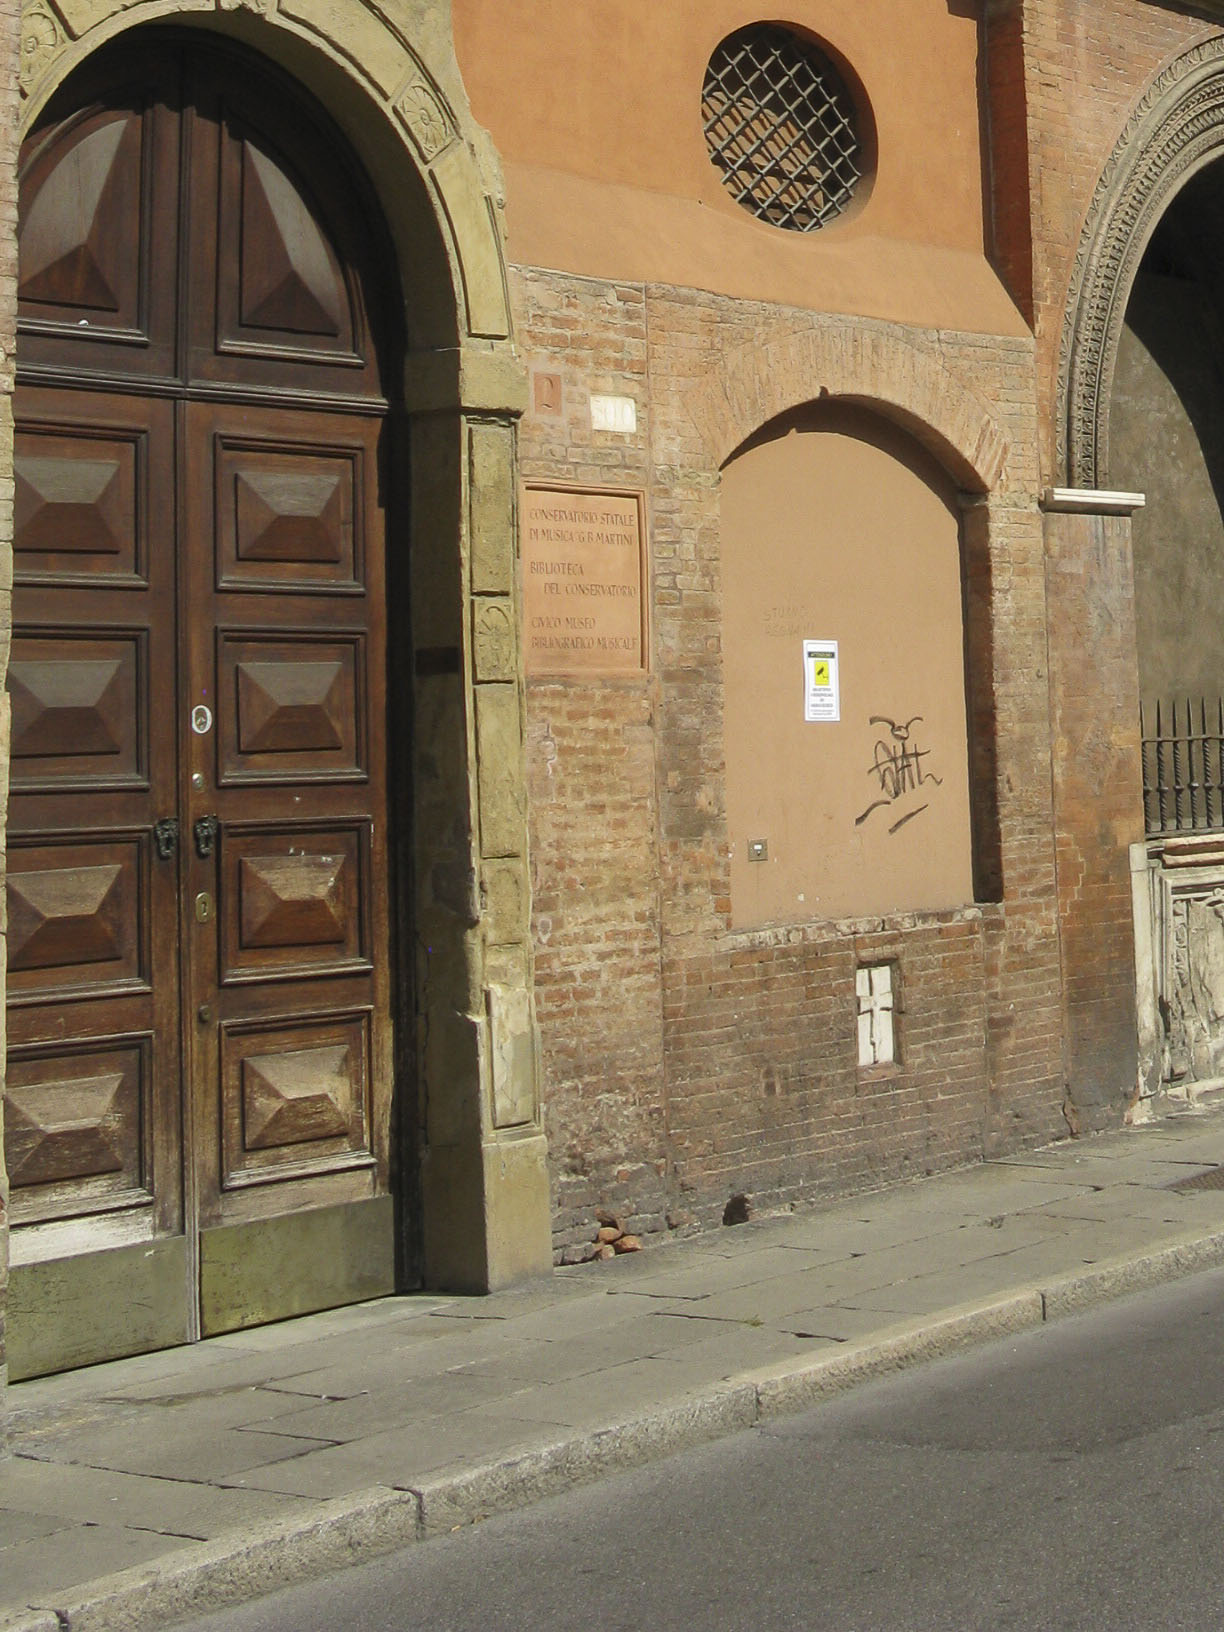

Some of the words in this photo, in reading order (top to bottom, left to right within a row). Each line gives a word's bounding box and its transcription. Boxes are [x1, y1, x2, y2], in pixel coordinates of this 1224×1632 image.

[529, 506, 597, 524] CONSERVATORIO
[599, 512, 634, 526] STATALE
[529, 527, 538, 540] DI
[539, 528, 573, 542] MUSICA
[530, 560, 584, 576] BIBLIOTECA
[544, 582, 560, 594] DEL
[565, 582, 635, 598] CONSERVATORIO
[531, 615, 561, 628] CIVICO
[565, 616, 595, 630] MUSEO
[531, 635, 593, 649] BIBLIOGRAFICO
[597, 637, 637, 650] MUSICALE
